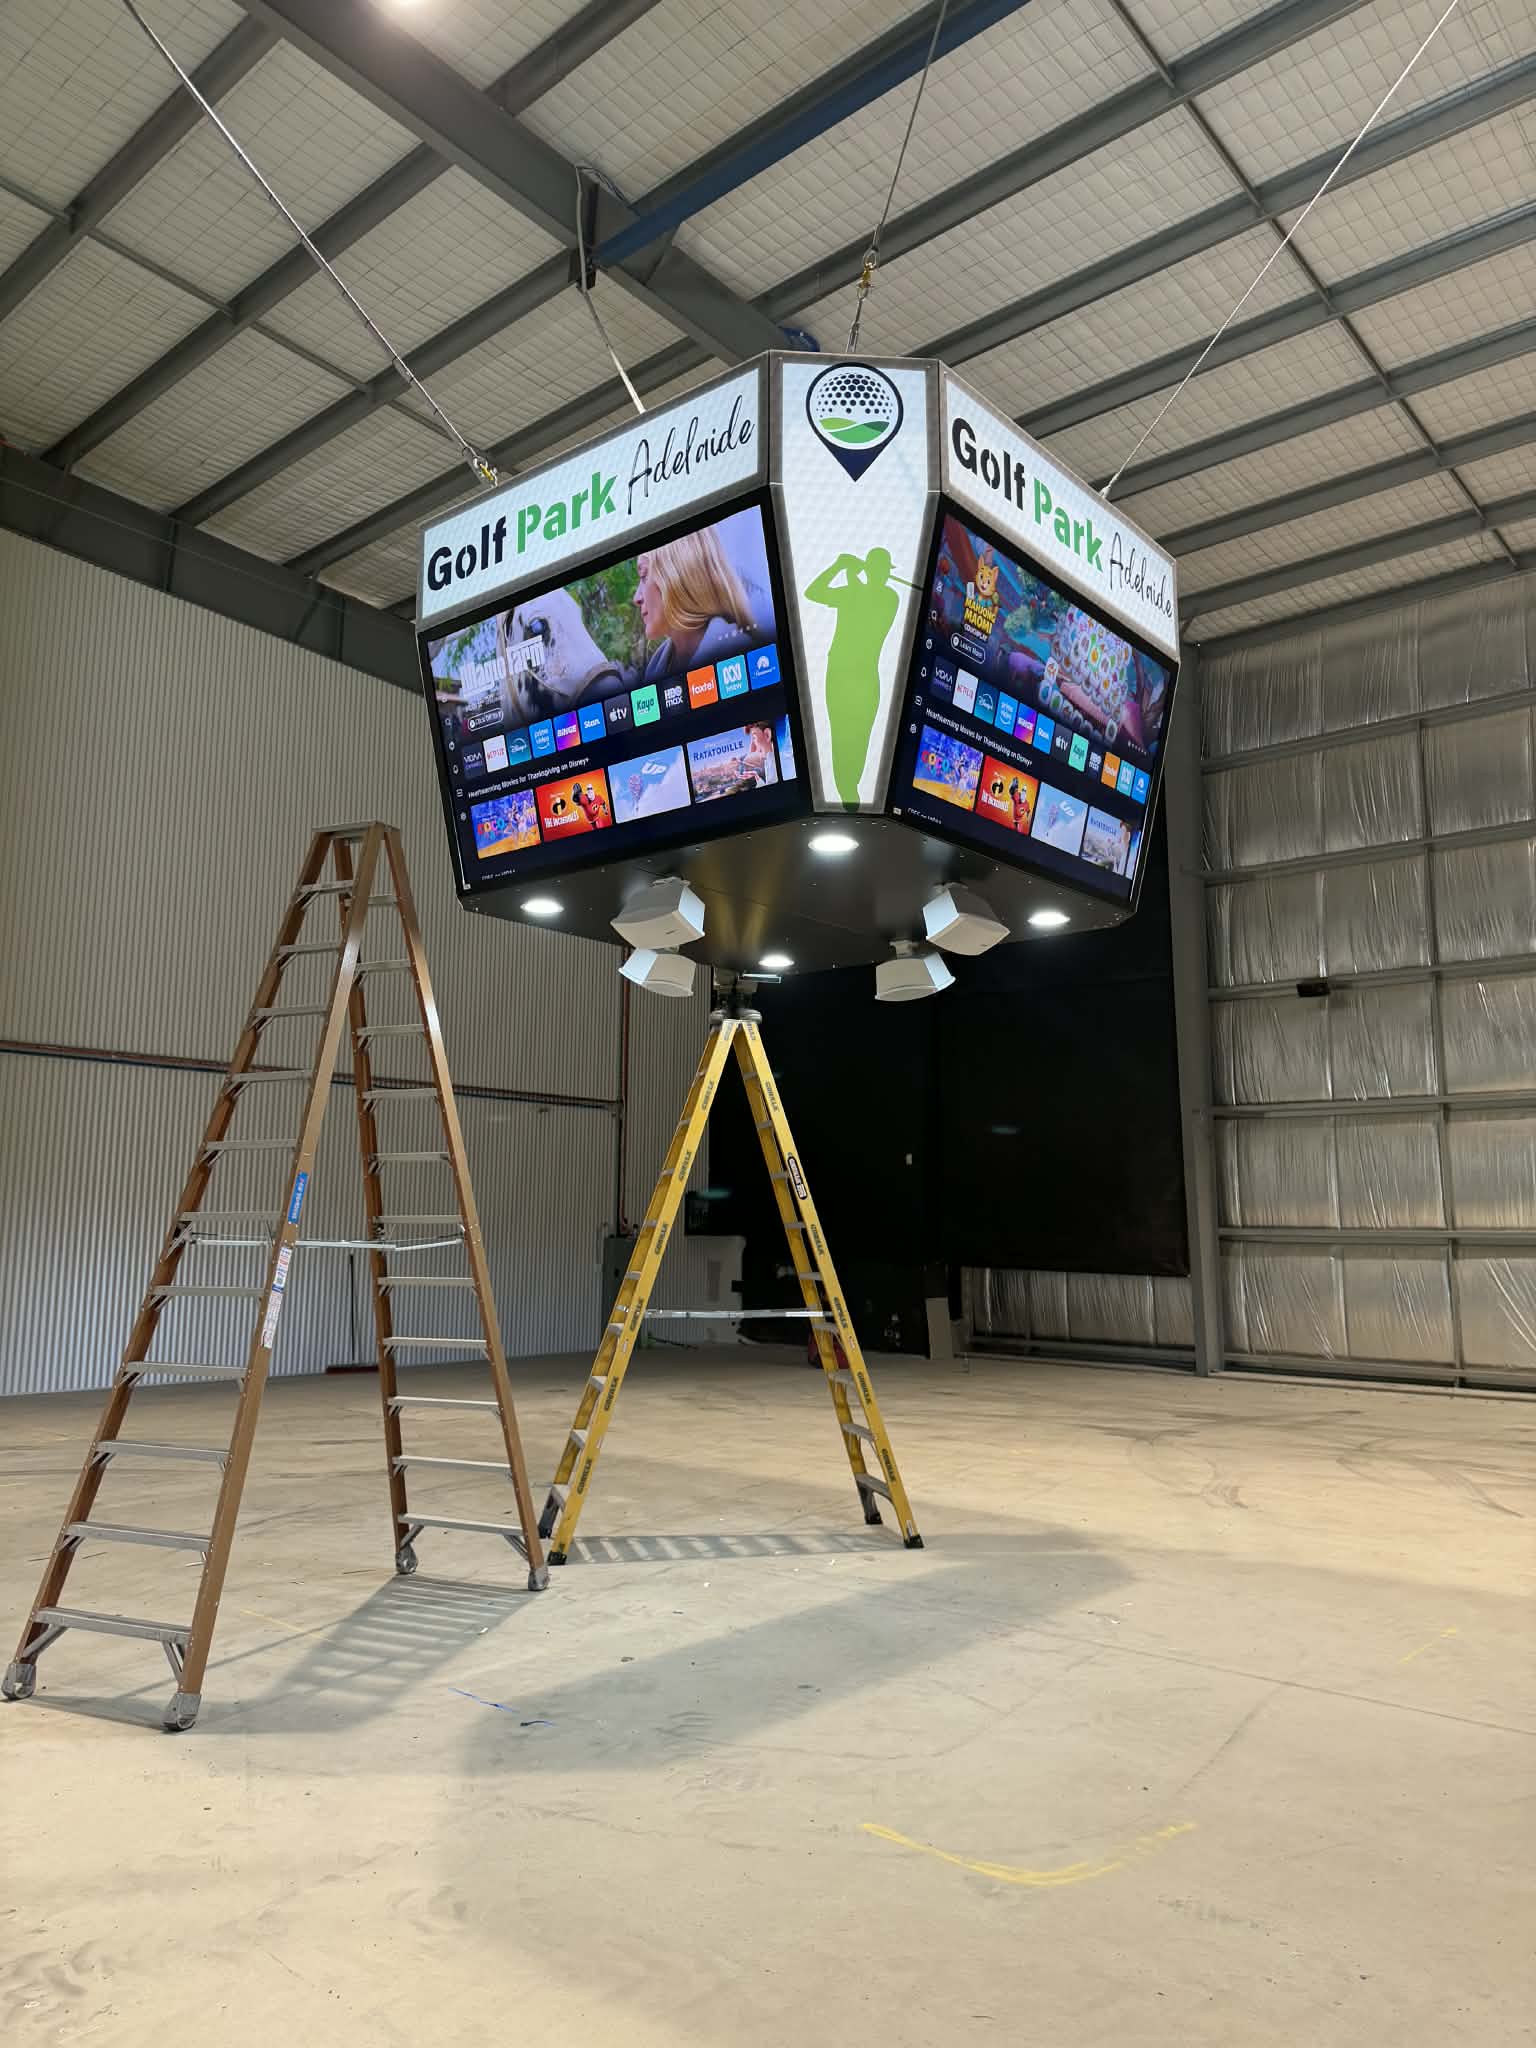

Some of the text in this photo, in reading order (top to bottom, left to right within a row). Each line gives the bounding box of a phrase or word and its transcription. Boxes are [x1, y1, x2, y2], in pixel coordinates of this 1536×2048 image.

[427, 394, 755, 591] Golf Park Adelaide
[952, 417, 1174, 618] Golf Park Adelaide
[964, 607, 992, 635] MAOMI
[664, 685, 683, 700] HBO
[691, 680, 714, 697] foxtel
[665, 695, 684, 709] max
[557, 724, 577, 737] BINGE
[693, 740, 745, 762] RATATOUILLE
[501, 777, 519, 789] Movies
[527, 765, 560, 781] Thanksgiving
[641, 761, 667, 776] UP
[1059, 800, 1075, 817] UP
